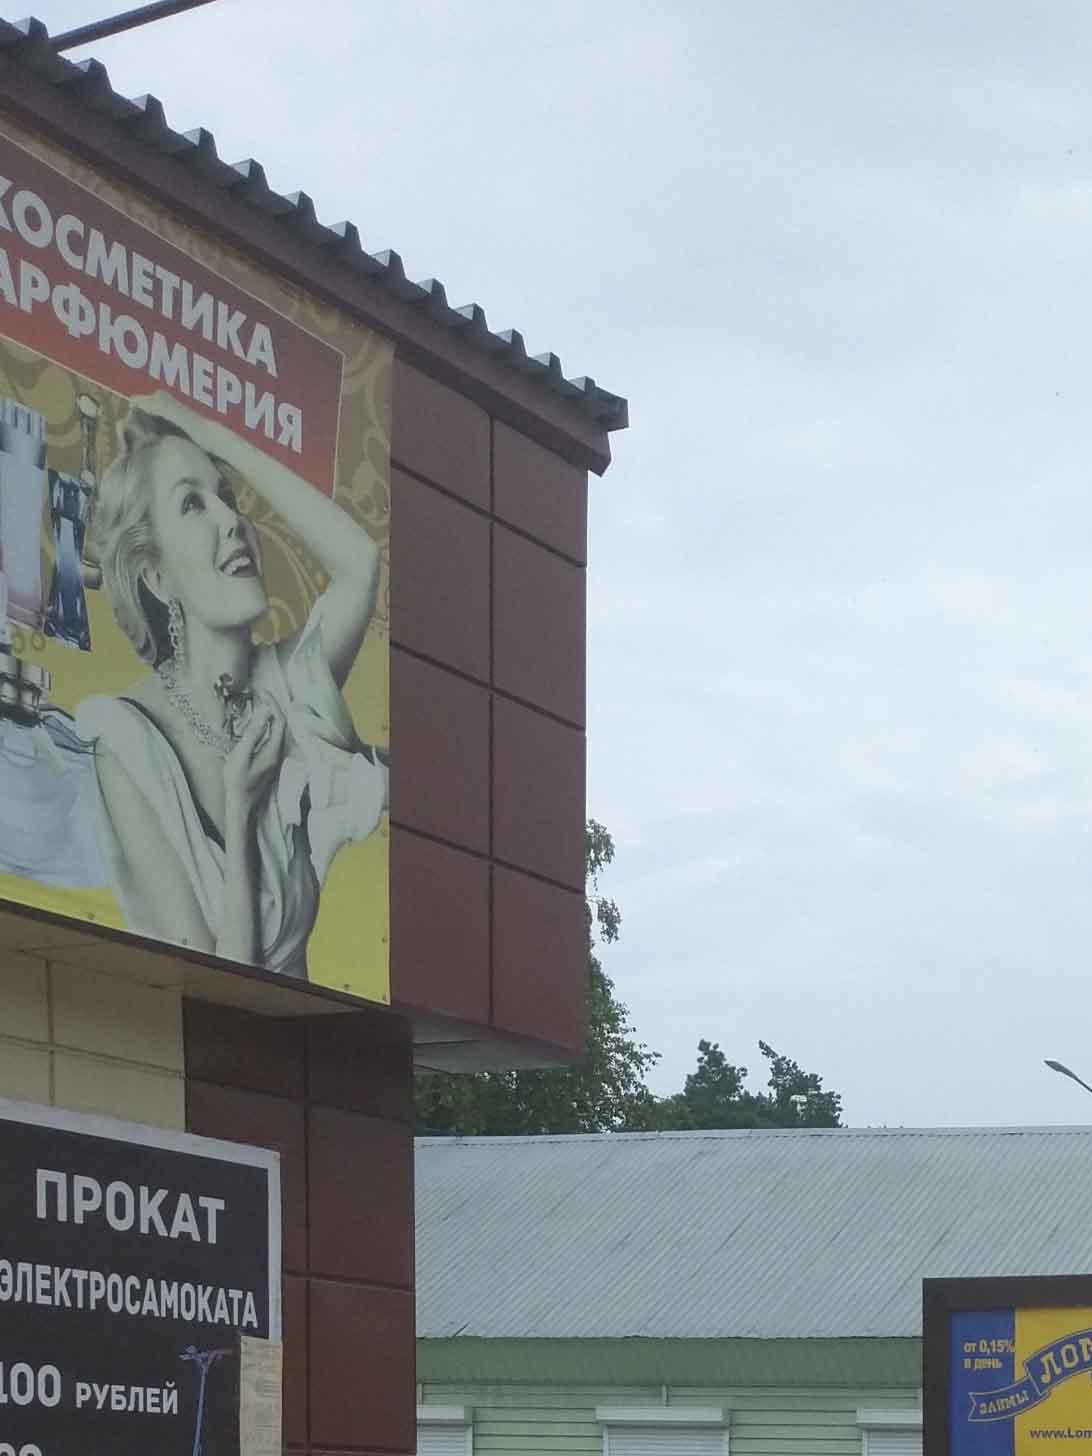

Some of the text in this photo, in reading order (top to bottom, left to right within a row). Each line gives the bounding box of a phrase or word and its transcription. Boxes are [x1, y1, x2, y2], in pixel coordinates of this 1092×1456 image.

[36, 1168, 225, 1245] ПРОКАТ
[0, 1259, 259, 1328] ЭЛЕКТРОСАМОКАТА
[75, 1379, 179, 1416] РУБЛЕЙ
